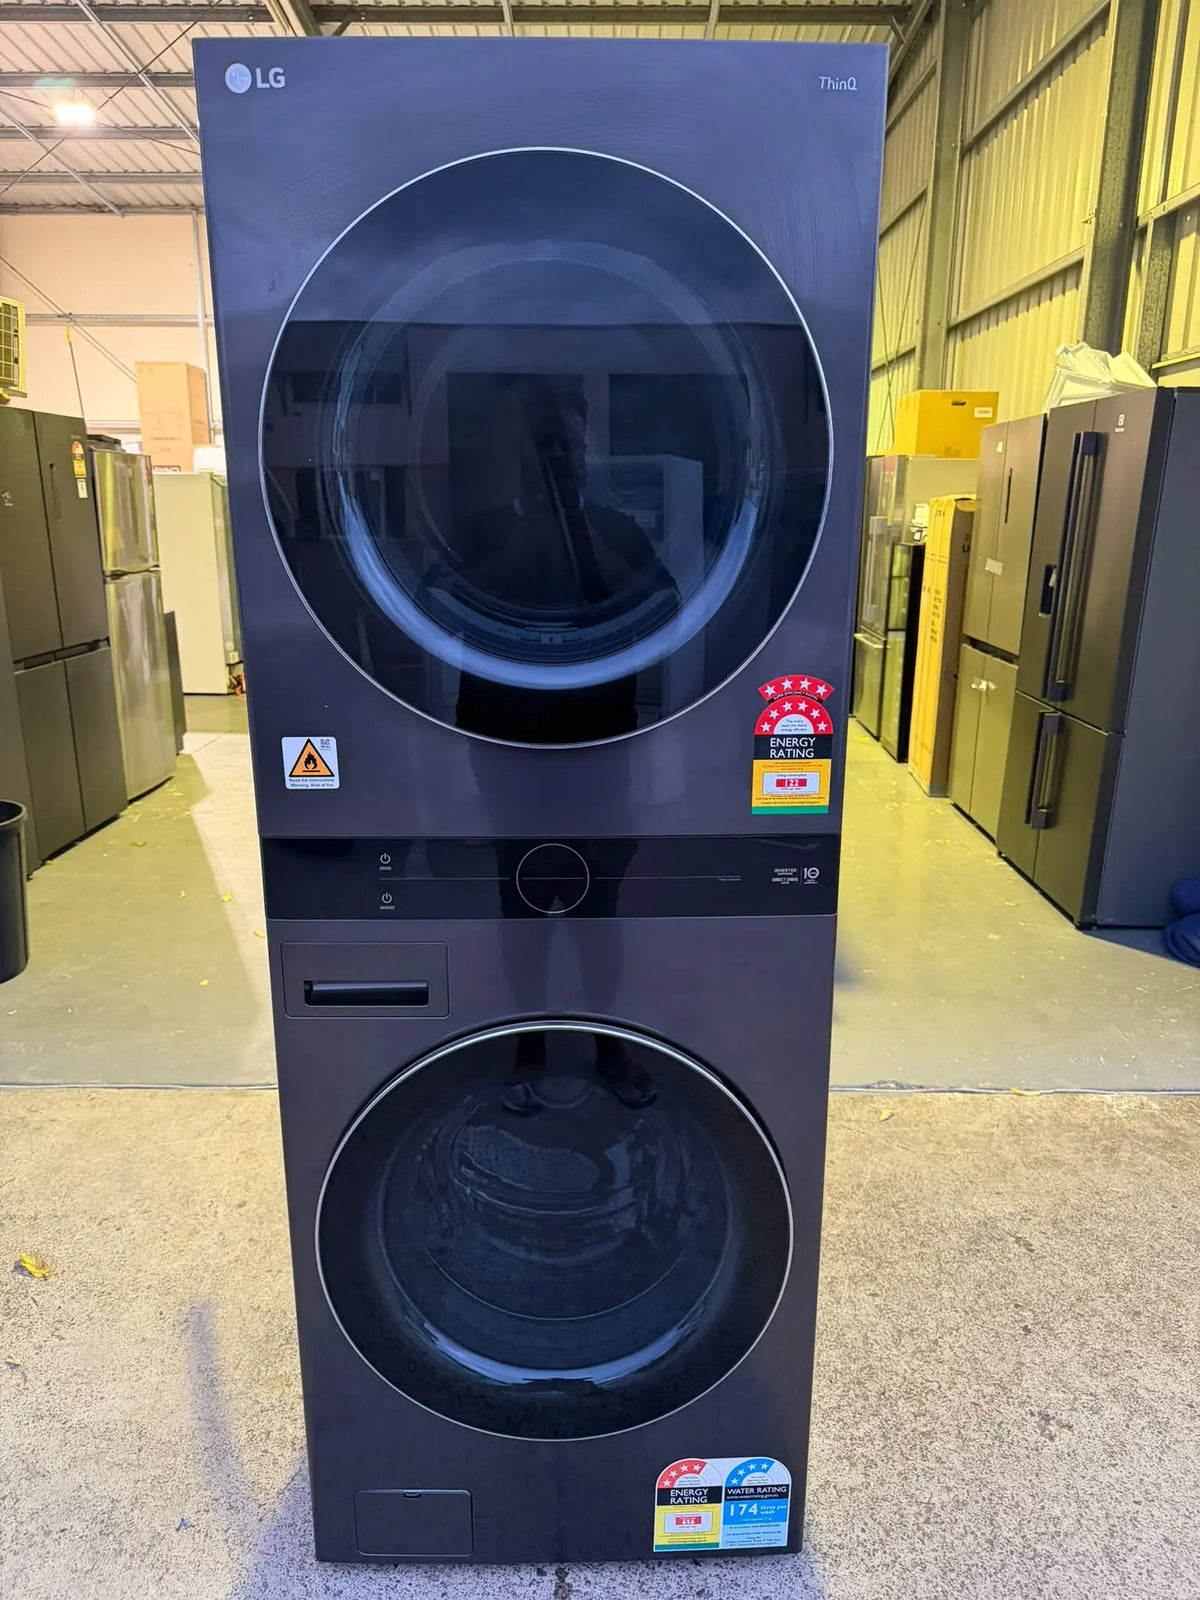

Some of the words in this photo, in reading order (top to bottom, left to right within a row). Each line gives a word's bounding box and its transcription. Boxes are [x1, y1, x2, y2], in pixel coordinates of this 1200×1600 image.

[255, 67, 286, 89] LG
[818, 76, 858, 91] ThinQ
[769, 737, 816, 748] ENERGY
[769, 748, 815, 759] RATING
[785, 779, 800, 787] 122
[670, 1488, 709, 1497] ENERGY
[756, 1486, 787, 1494] RATING
[669, 1496, 708, 1505] RATING
[729, 1502, 758, 1517] 174
